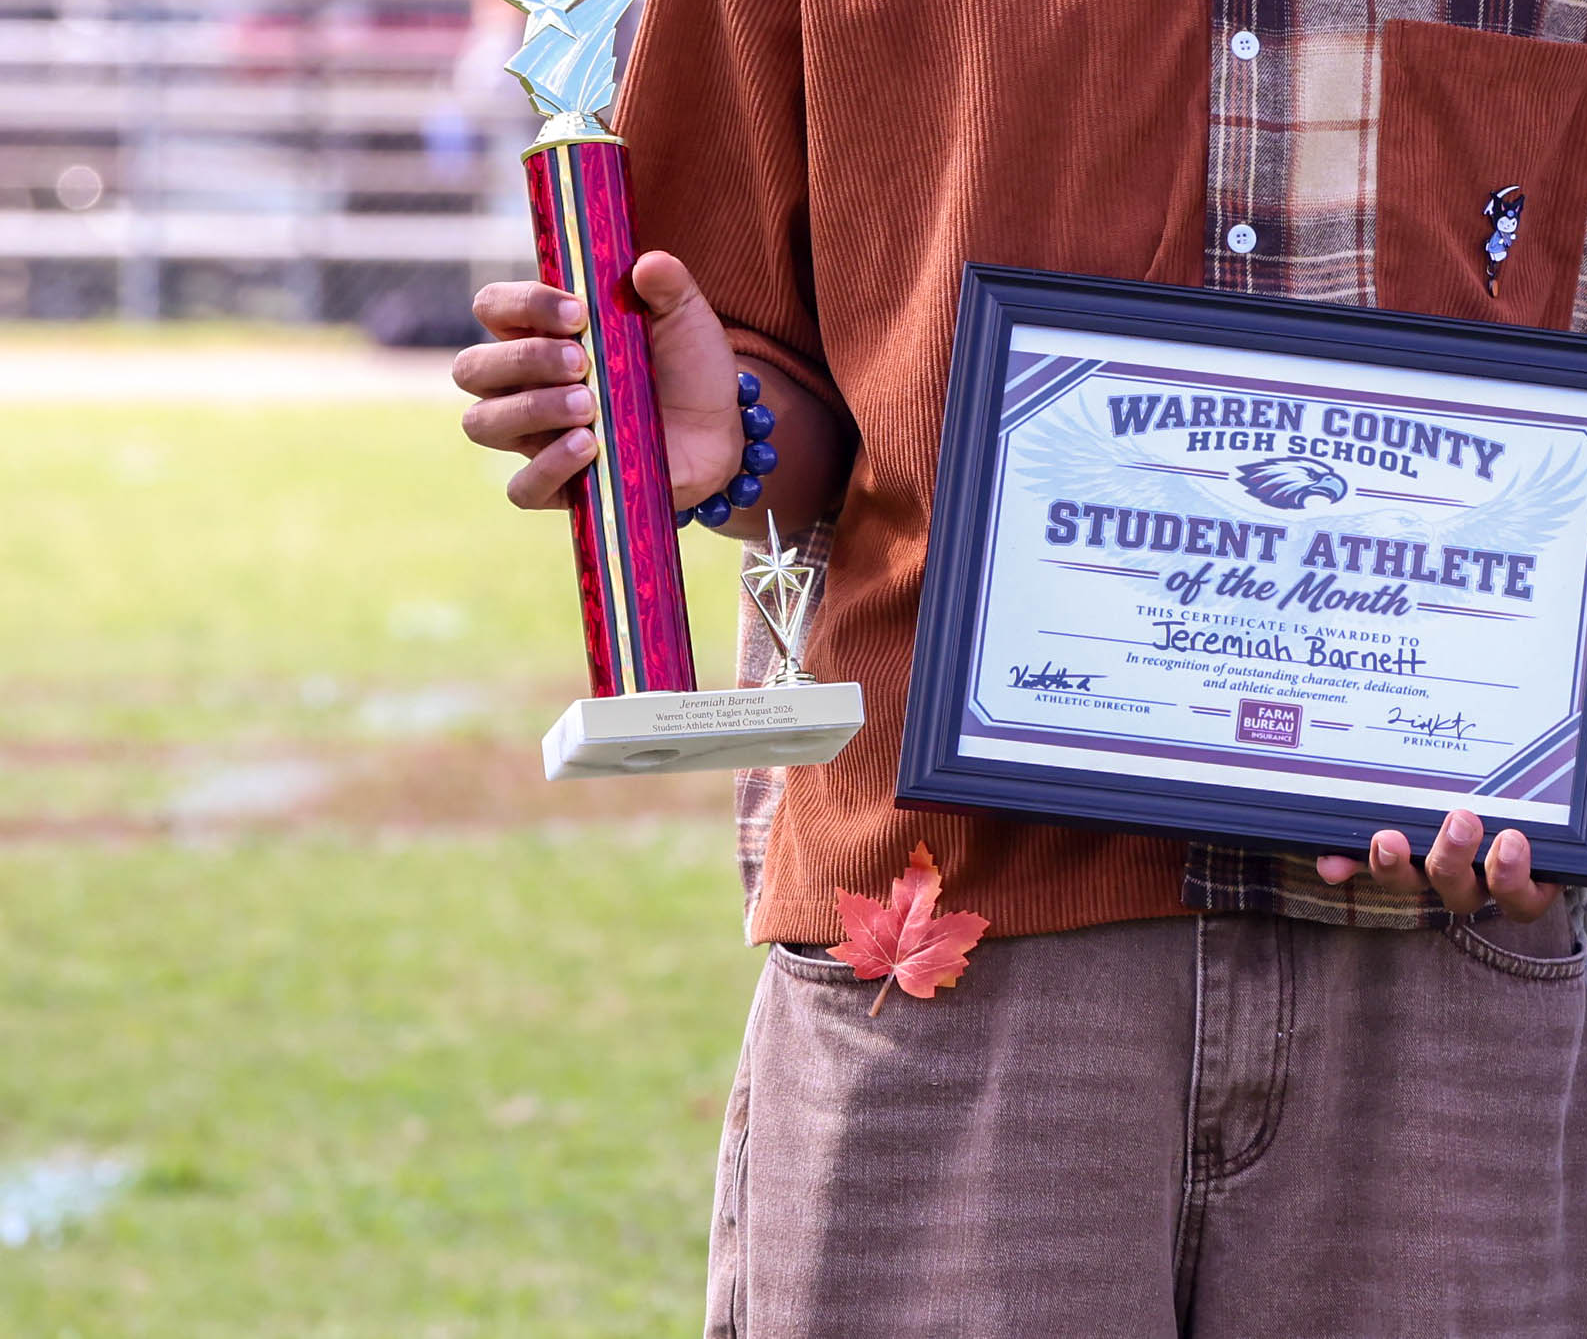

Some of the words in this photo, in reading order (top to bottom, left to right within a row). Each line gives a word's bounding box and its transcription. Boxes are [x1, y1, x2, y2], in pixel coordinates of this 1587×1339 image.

[1107, 394, 1306, 437] WARREN
[1323, 406, 1505, 482] COUNTY
[1187, 431, 1276, 452] HIGH
[1288, 435, 1418, 479] SCHOOL
[1044, 499, 1287, 564] STUDENT
[1301, 528, 1537, 602] ATHLETE
[1166, 563, 1213, 613] of
[1217, 567, 1277, 601] the
[1278, 572, 1417, 616] Month
[1137, 605, 1173, 619] THIS
[1181, 610, 1286, 632] CERTIFICATE
[1294, 623, 1307, 634] IS
[1315, 626, 1391, 644] AWARDED
[1400, 636, 1419, 647] TO
[1152, 621, 1292, 662] Jeremiah
[1304, 636, 1426, 675] Barnett
[1126, 652, 1138, 663] In
[1142, 655, 1210, 672] recognition
[1213, 661, 1228, 677] of
[1227, 665, 1299, 684] outstanding
[1302, 673, 1360, 691] character,
[1364, 681, 1430, 698] dedication,
[680, 698, 725, 709] Jeremiah
[728, 696, 764, 706] Barnett
[1203, 678, 1227, 690] and
[1229, 680, 1274, 696] athletic
[1276, 687, 1348, 704] achievement.
[656, 713, 683, 721] Warren
[686, 711, 713, 720] County
[716, 708, 742, 718] Eagles
[744, 708, 771, 716] August
[773, 705, 793, 714] 2026
[1034, 693, 1090, 707] ATHLETIC
[1094, 701, 1150, 714] DIRECTOR
[1259, 708, 1294, 721] FARM
[653, 722, 713, 733] Student-Athlete
[715, 720, 740, 728] Award
[743, 718, 765, 726] Cross
[767, 716, 798, 725] Country
[1244, 717, 1294, 732] BUREAU
[1251, 732, 1292, 742] INSURANCE
[1403, 736, 1468, 751] PRINCIPAL
